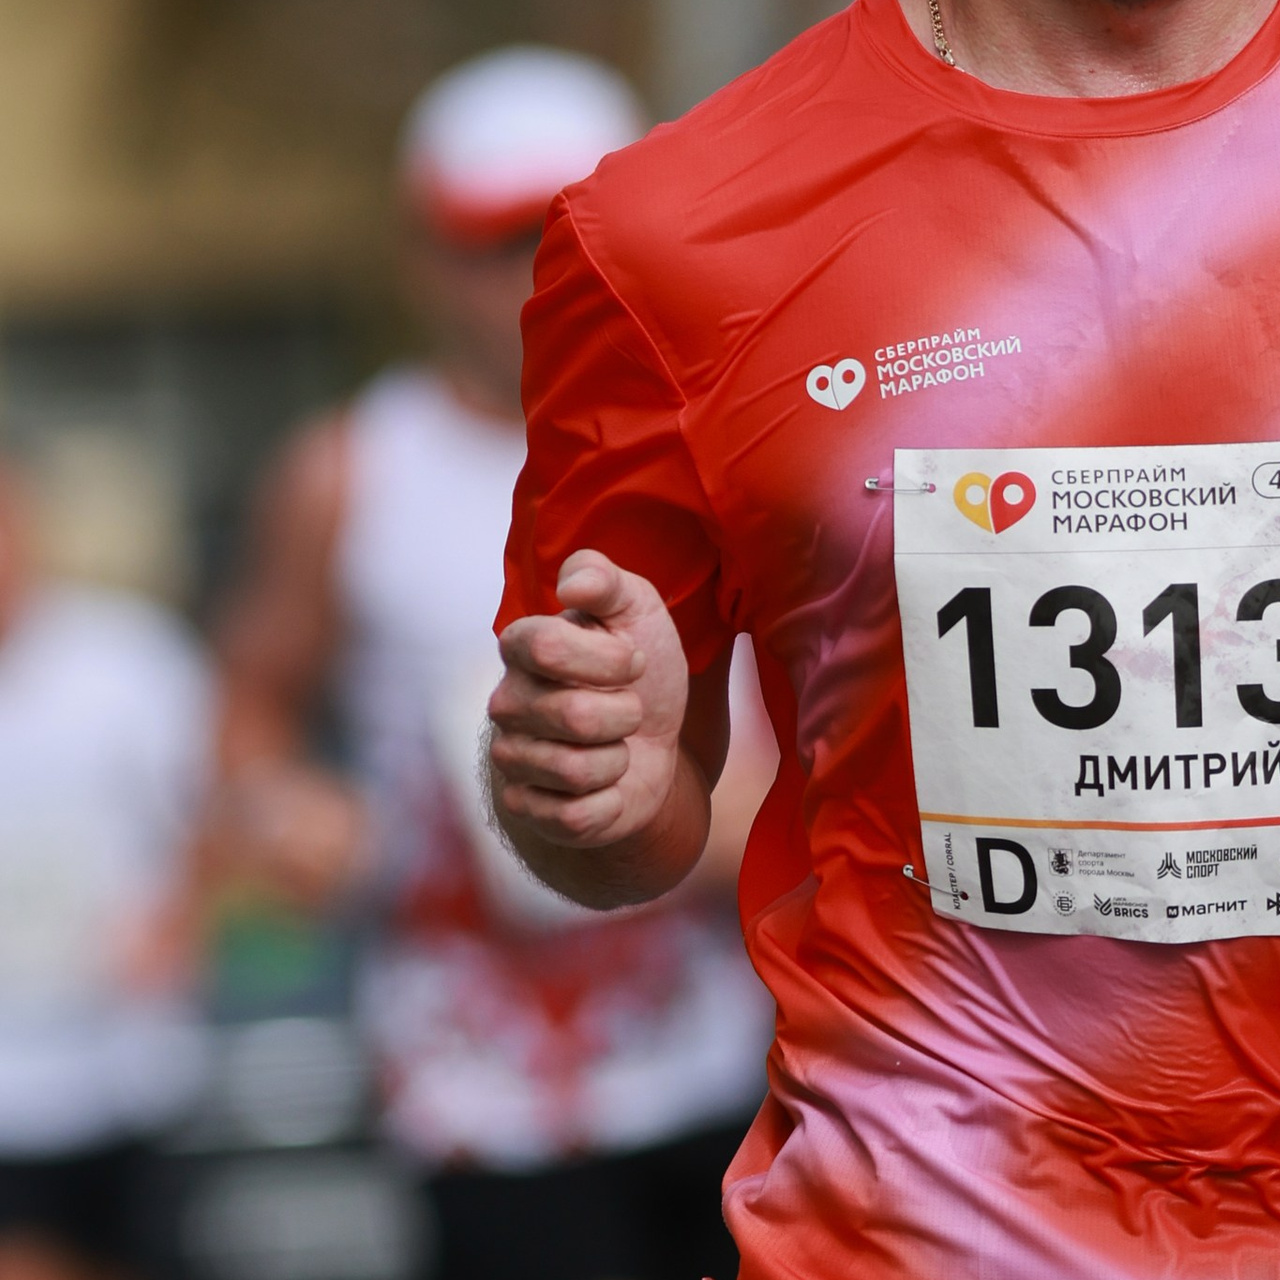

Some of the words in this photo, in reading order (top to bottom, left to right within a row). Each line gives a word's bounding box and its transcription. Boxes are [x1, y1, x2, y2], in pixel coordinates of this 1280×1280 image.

[874, 328, 981, 362] СБЕРПРАЙМ
[876, 336, 1023, 381] МОСКОВСКИЙ
[880, 362, 986, 399] МАРАФОН
[1051, 465, 1186, 485] СБЕРПРАЙМ
[1052, 483, 1237, 510] МОСКОВСКИЙ
[1052, 512, 1188, 534] МАРАФОН
[944, 832, 955, 866] CORRAL
[1186, 844, 1257, 863] МОСКОВСКИЙ
[975, 837, 1038, 915] D
[1186, 863, 1219, 879] СПОРТ
[950, 872, 960, 910] КЛАСТЕР
[1113, 907, 1149, 919] BRICS
[1182, 900, 1247, 917] магнит
